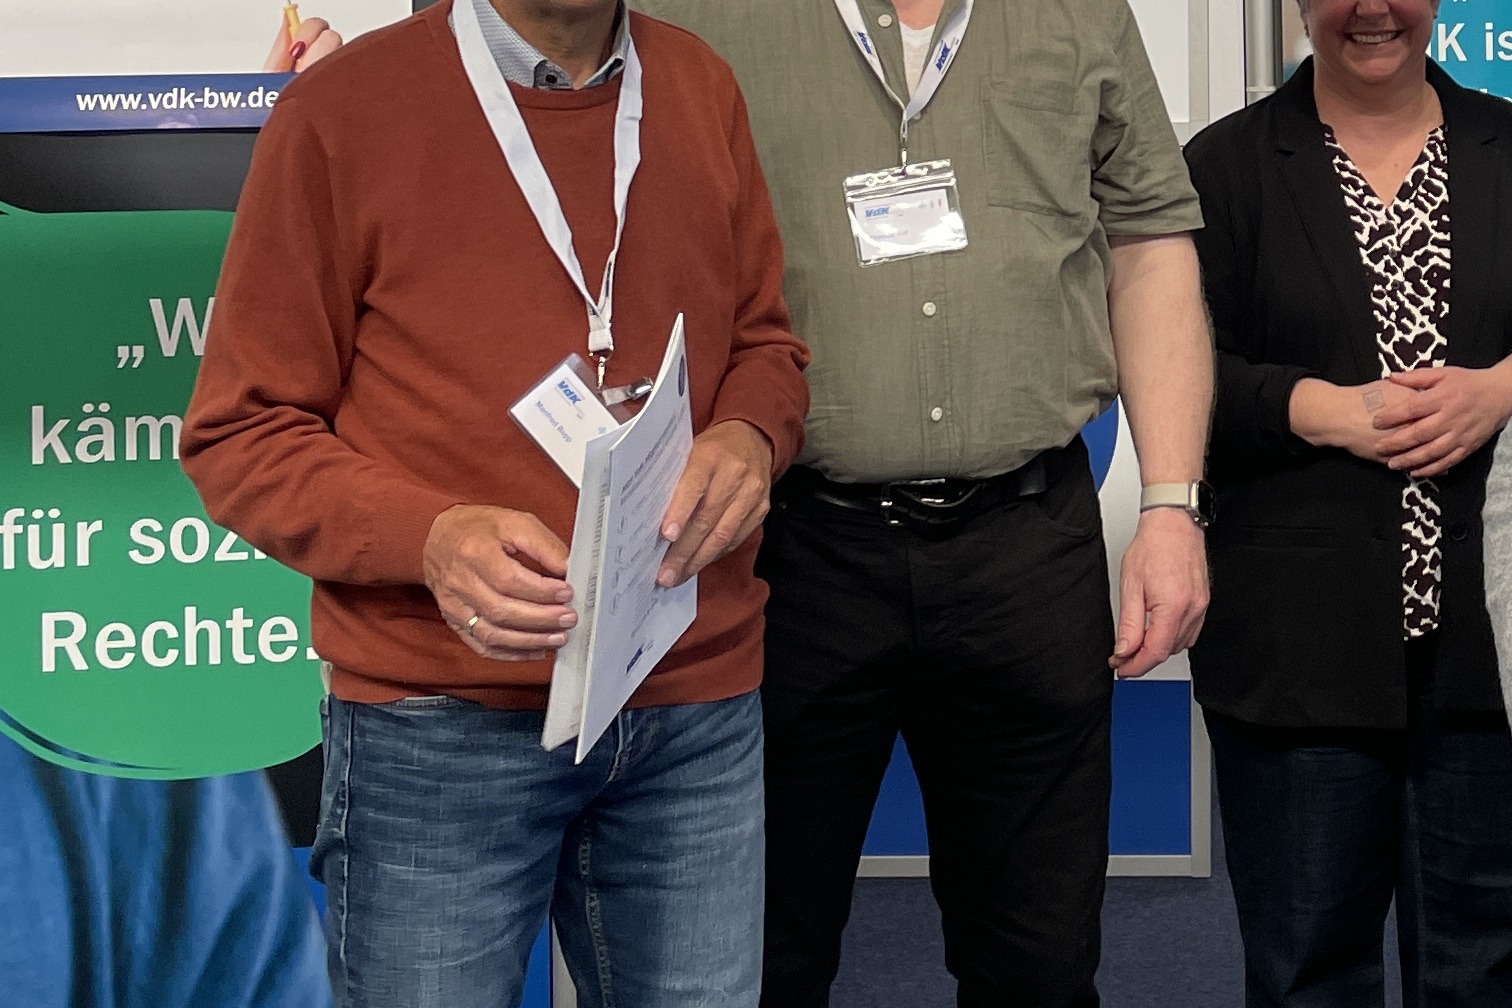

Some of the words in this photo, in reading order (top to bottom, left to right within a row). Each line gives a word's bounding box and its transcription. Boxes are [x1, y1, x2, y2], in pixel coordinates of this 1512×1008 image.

[1427, 22, 1468, 63] K
[76, 86, 280, 111] www.vdk-bw.de
[116, 296, 216, 369] „W
[31, 402, 183, 465] käm
[0, 507, 103, 570] für
[128, 516, 269, 565] soz
[41, 607, 319, 673] Rechte.
